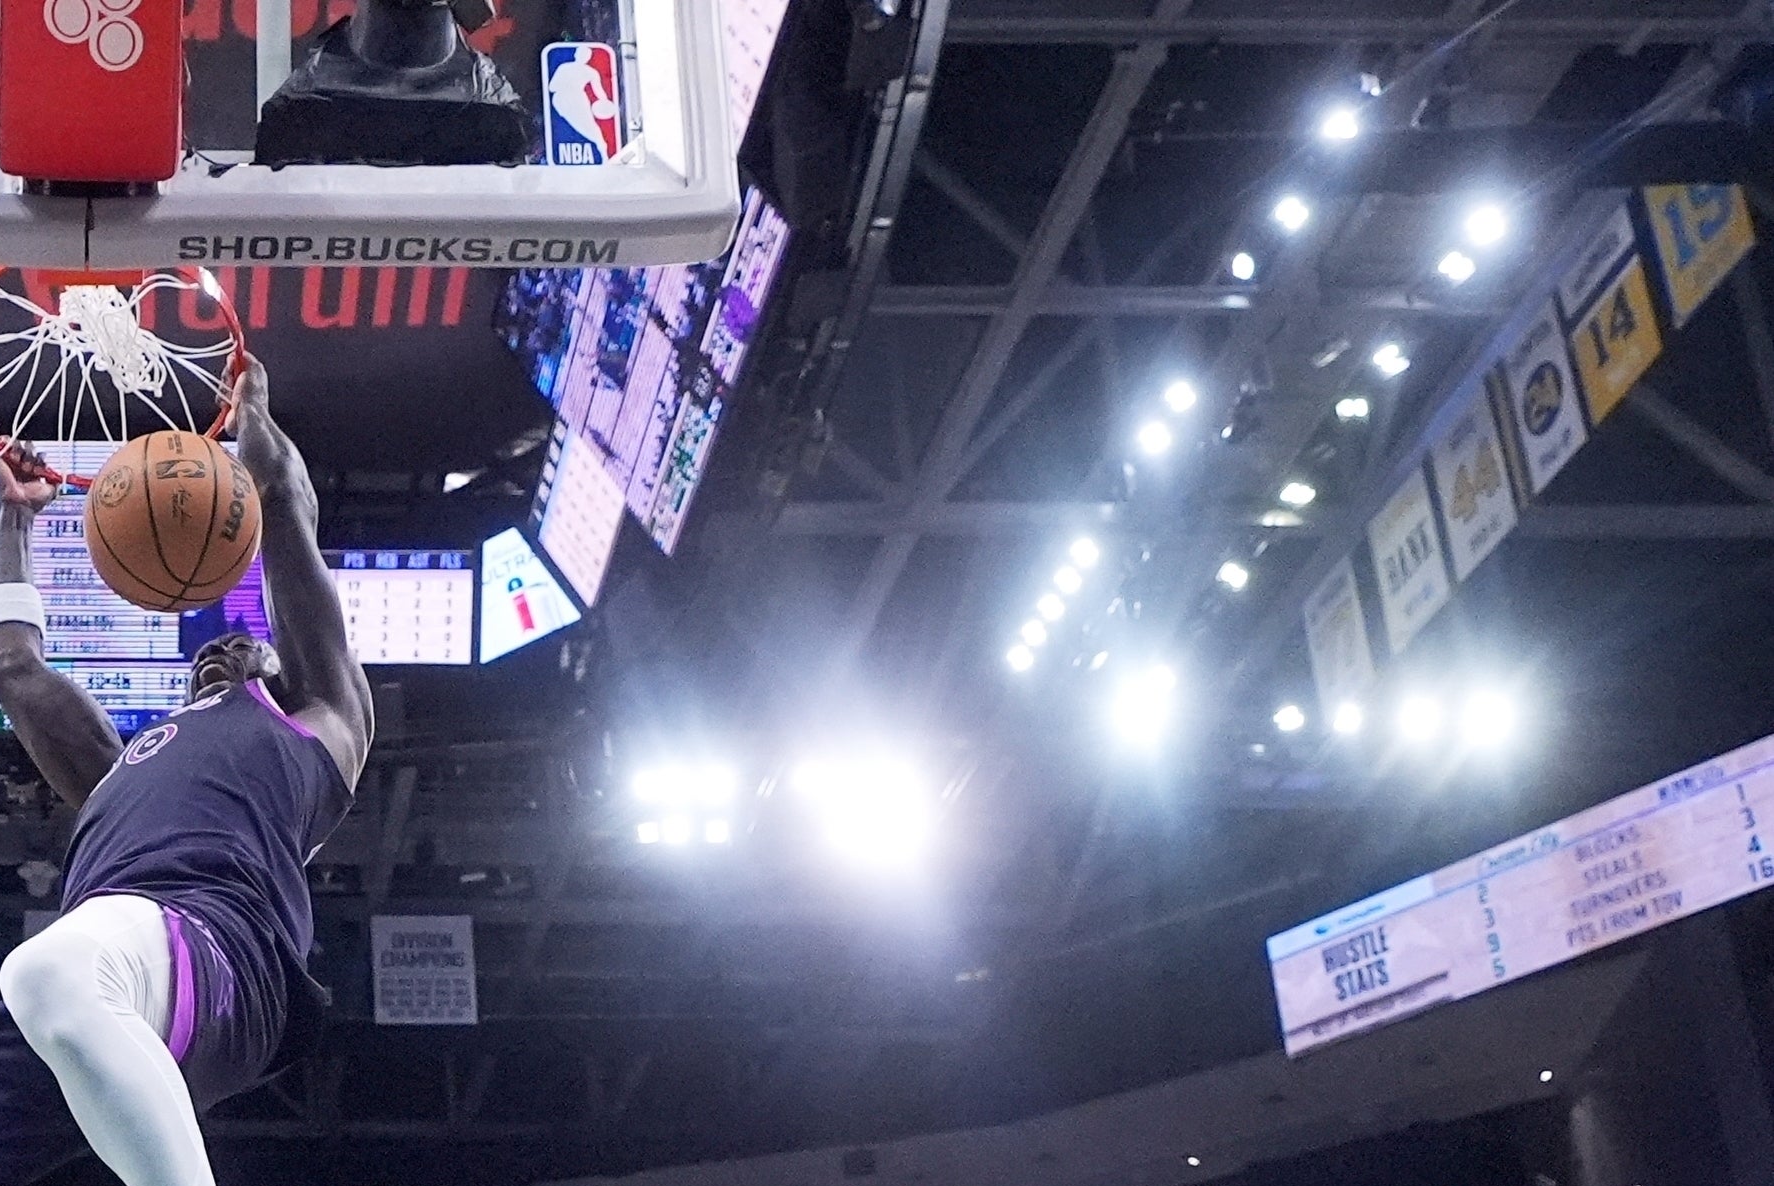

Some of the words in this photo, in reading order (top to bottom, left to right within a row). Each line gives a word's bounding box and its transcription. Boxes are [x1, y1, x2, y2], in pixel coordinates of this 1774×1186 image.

[558, 142, 595, 164] NBA
[178, 236, 620, 264] SHOP.BUCKS.COM
[1589, 284, 1638, 368] 14
[1737, 783, 1746, 802] 1
[1740, 807, 1756, 831] 3
[1748, 833, 1763, 853] 4
[1748, 856, 1774, 883] 16
[1334, 957, 1390, 1001] STATS
